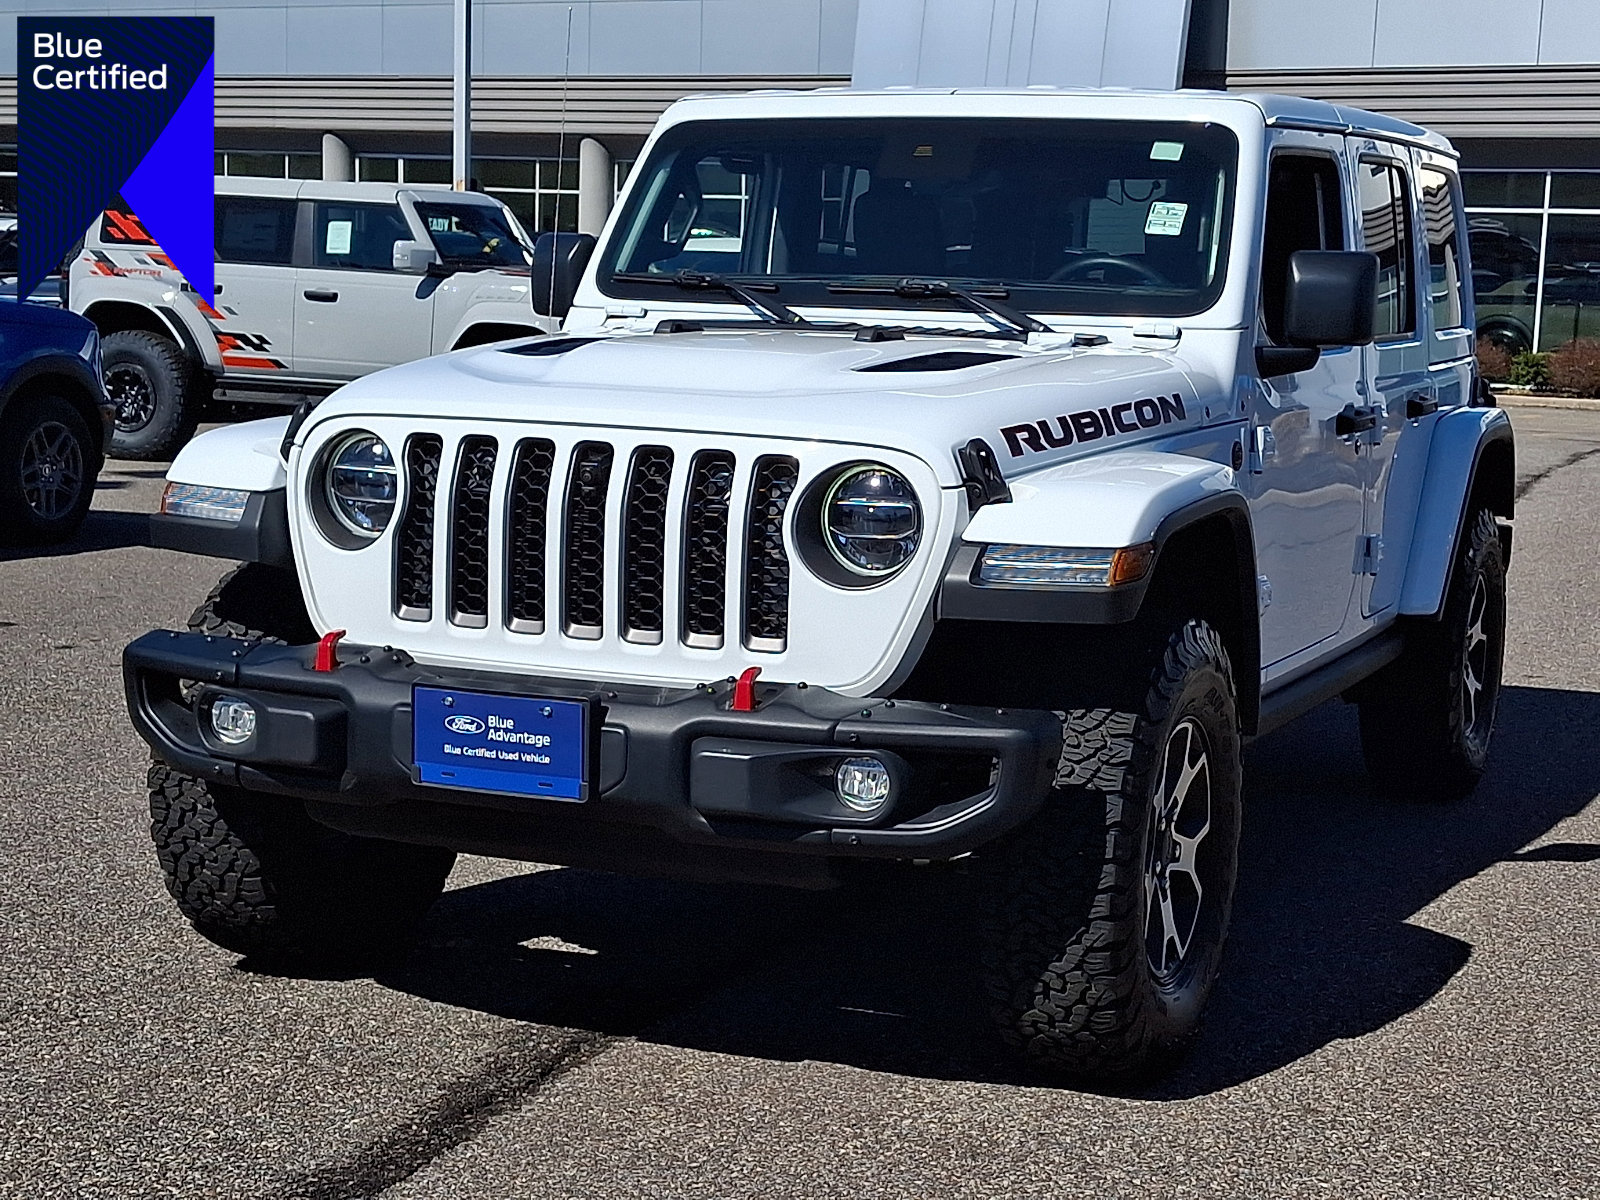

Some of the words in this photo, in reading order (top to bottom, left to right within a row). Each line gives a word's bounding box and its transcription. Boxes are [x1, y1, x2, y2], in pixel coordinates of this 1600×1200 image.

[1000, 393, 1187, 457] RUBICON
[452, 717, 478, 731] Ford
[487, 715, 514, 729] Blue
[487, 729, 551, 747] Advantage
[443, 744, 461, 754] Blue
[463, 747, 496, 758] Certified
[498, 751, 519, 760] Used
[521, 752, 550, 764] Vehicle
